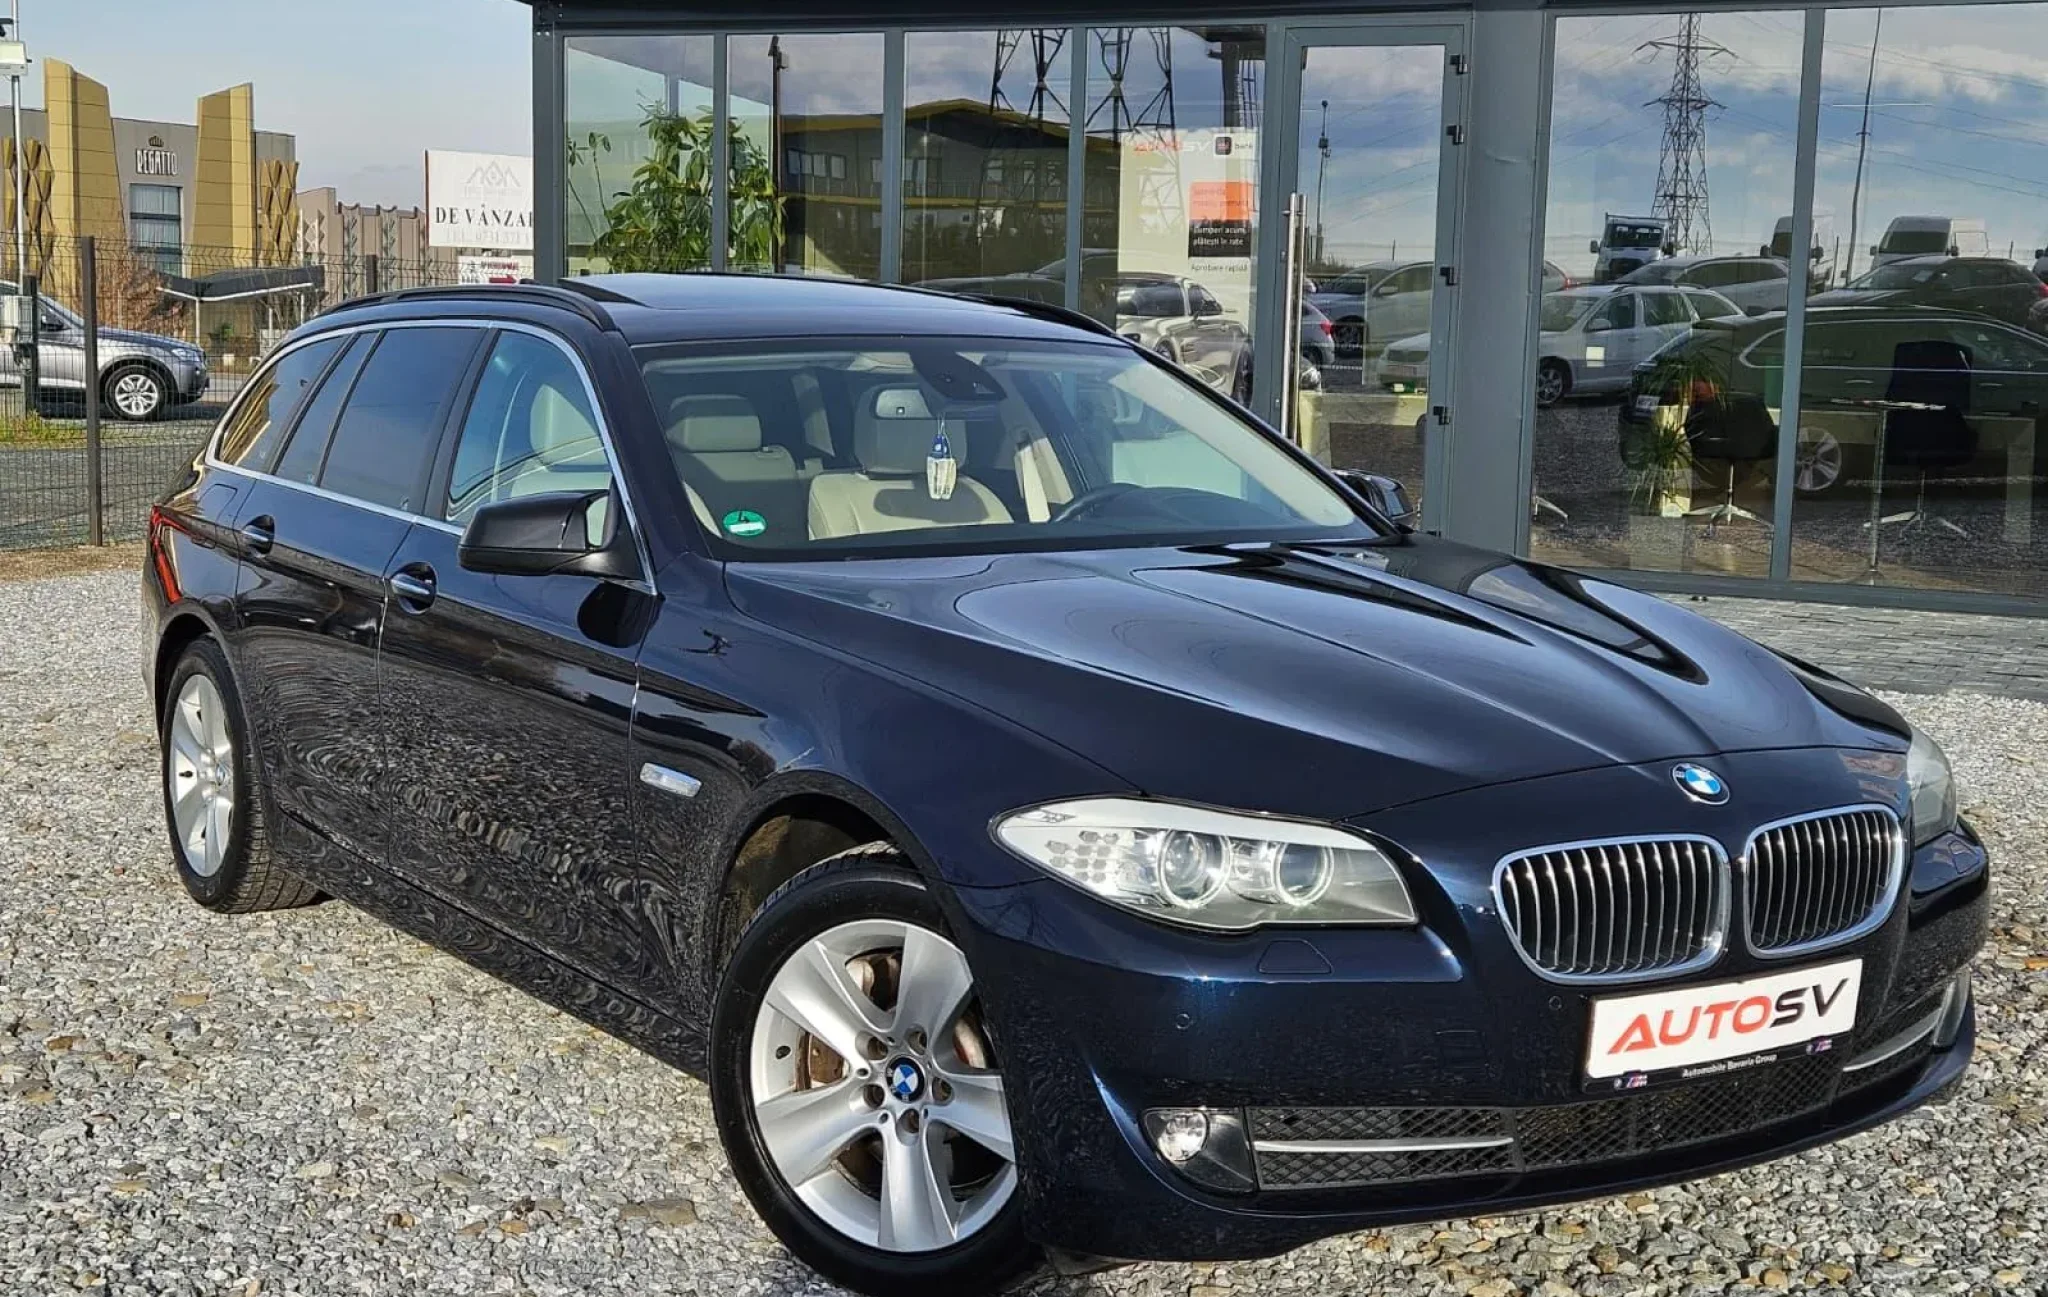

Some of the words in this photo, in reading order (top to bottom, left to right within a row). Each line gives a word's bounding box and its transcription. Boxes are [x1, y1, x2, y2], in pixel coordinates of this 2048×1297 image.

[136, 149, 178, 176] REGATTO
[435, 206, 459, 225] DE
[1607, 977, 1849, 1055] AUTOSV
[1682, 1063, 1727, 1079] Automobile
[1727, 1057, 1755, 1071] Bavaria
[1755, 1054, 1778, 1065] Group
